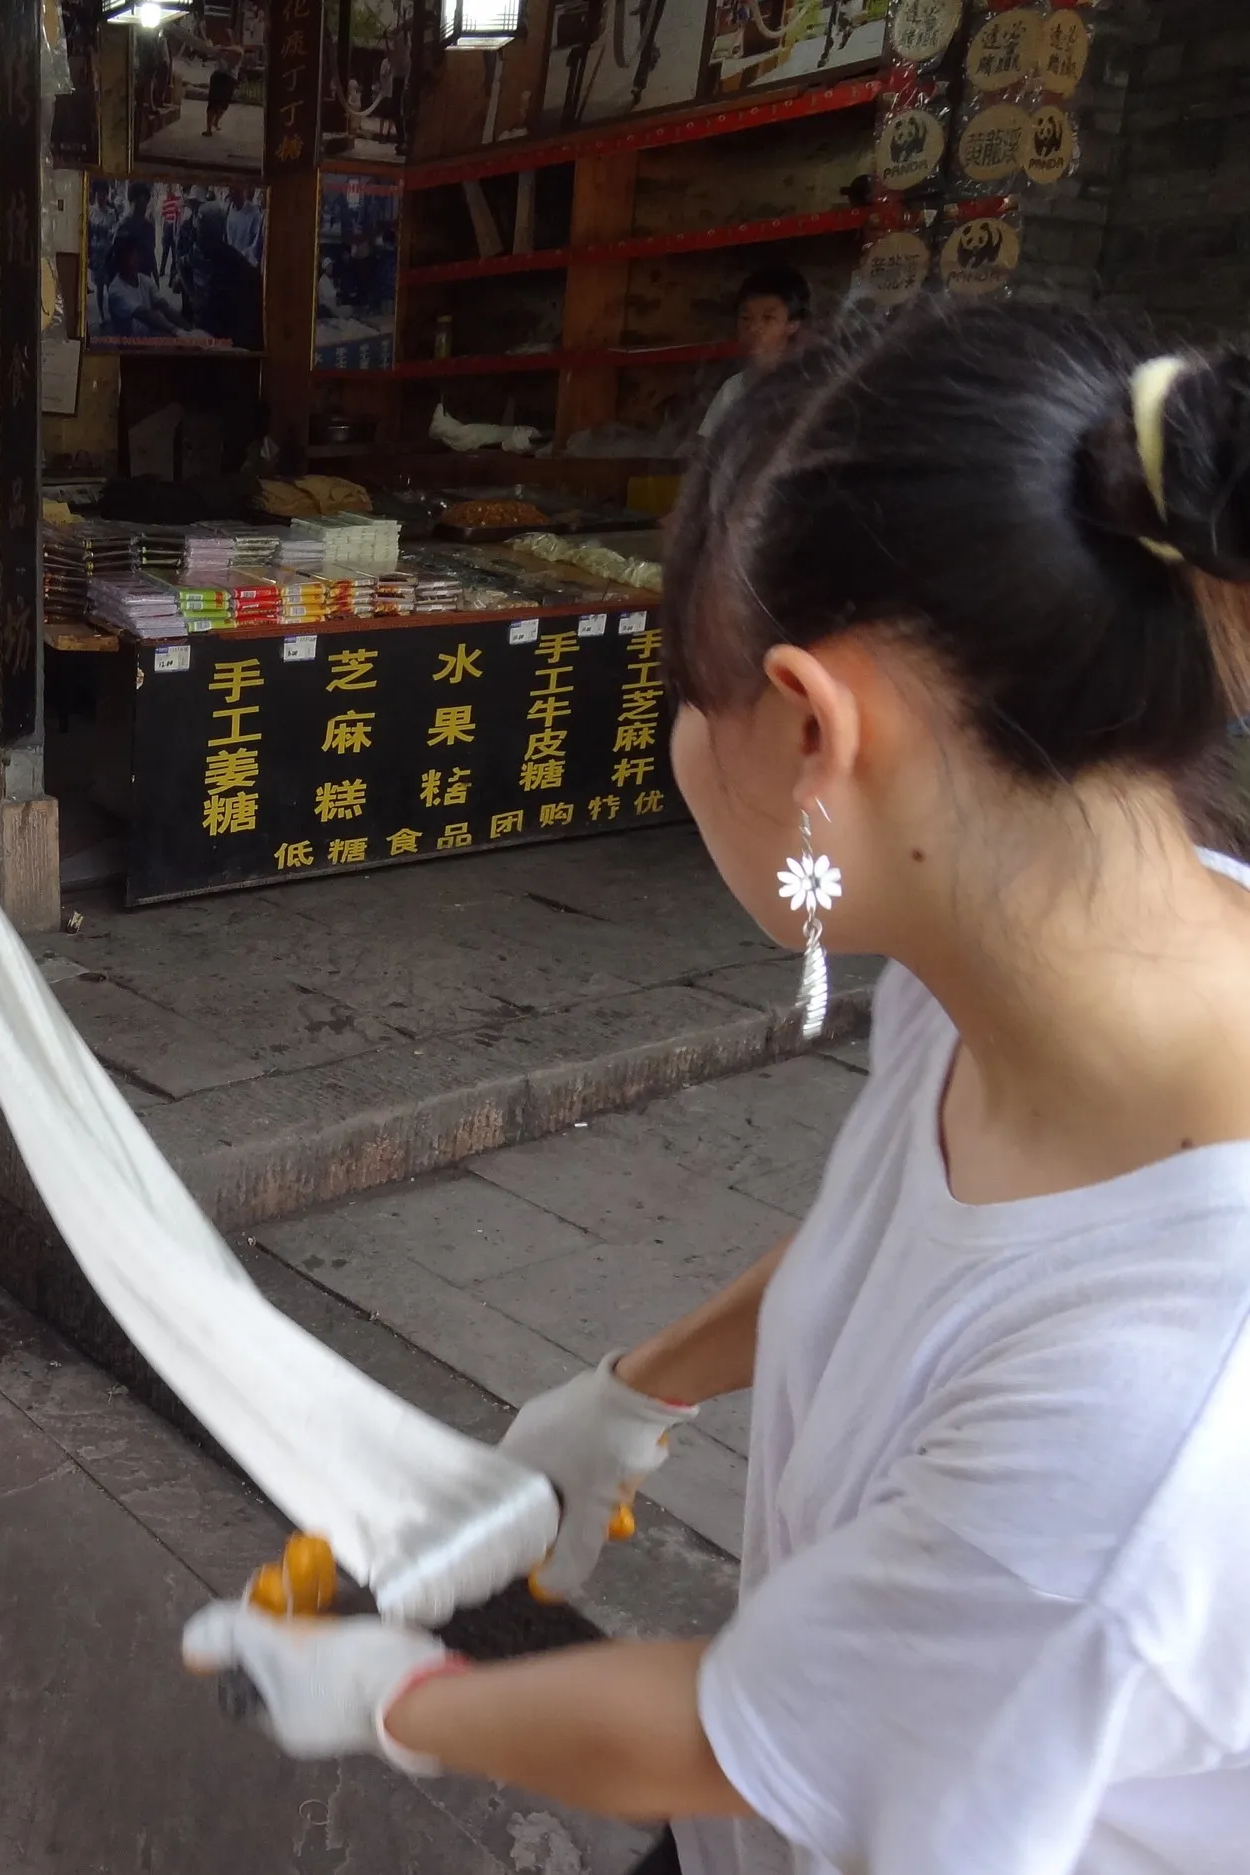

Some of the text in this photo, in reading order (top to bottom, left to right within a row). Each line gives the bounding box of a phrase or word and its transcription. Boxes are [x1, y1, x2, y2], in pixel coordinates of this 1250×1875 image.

[883, 159, 929, 178] PANDA
[1028, 157, 1065, 171] PANDA
[203, 658, 265, 837] 手工姜糖
[314, 649, 379, 823] 芝麻糕
[520, 631, 580, 792] 手工牛皮糖
[611, 628, 664, 788] 手工芝麻杆
